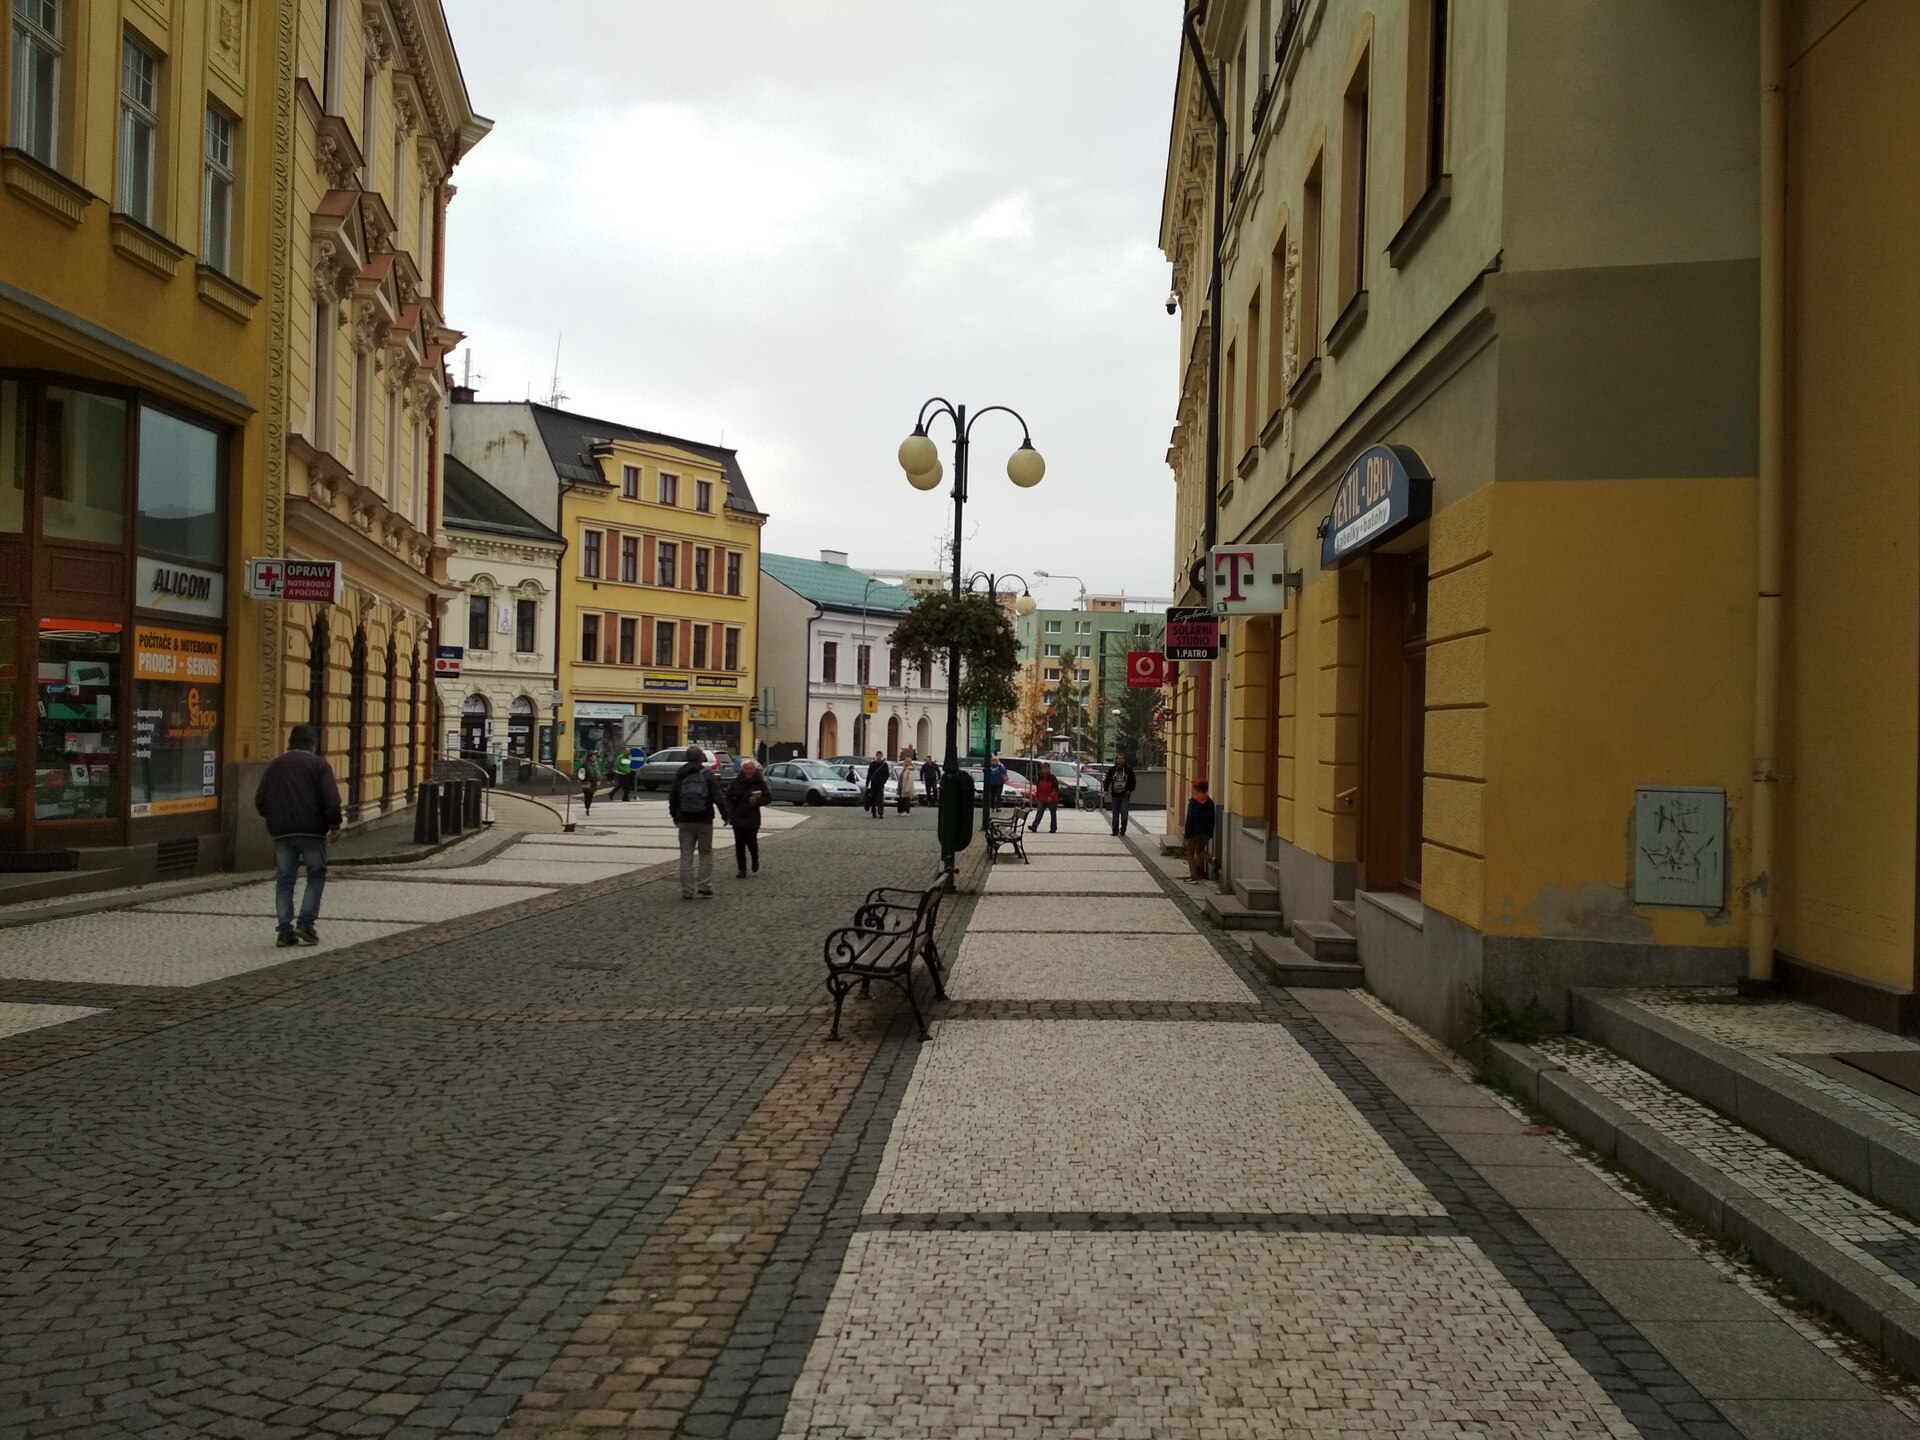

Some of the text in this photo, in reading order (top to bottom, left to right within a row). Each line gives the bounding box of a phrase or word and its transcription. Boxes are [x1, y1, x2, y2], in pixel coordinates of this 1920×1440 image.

[1333, 467, 1360, 530] TEXTIL
[1366, 456, 1393, 507] OBUV
[1336, 507, 1387, 547] kabelky batohy
[287, 565, 332, 578] OPRAVY
[1215, 552, 1254, 601] T
[152, 568, 211, 601] ALICOM
[287, 579, 332, 589] NOTEBOOKŮ
[288, 588, 294, 596] A
[138, 632, 218, 655] POČÍTAČE & NOTEBOOKY
[1176, 635, 1210, 646] STUDIO
[138, 652, 177, 674] PRODEJ
[186, 657, 218, 676] SERVIS
[1176, 649, 1208, 658] 1.PATRO
[188, 687, 200, 710] e
[190, 709, 217, 731] shop
